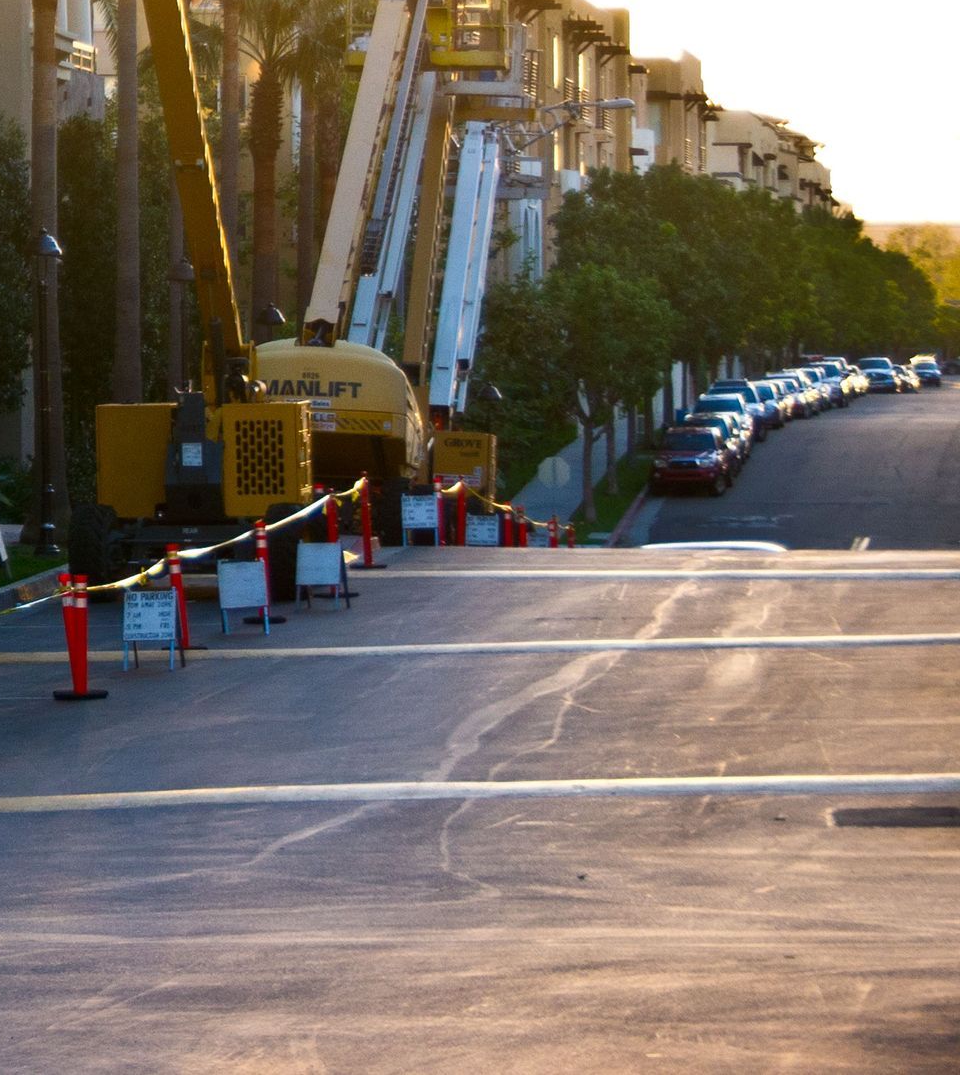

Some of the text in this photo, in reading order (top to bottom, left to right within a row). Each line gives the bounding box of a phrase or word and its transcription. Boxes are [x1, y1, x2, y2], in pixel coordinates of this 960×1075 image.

[262, 379, 362, 398] MANLIFT
[126, 592, 173, 602] NO PARKING
